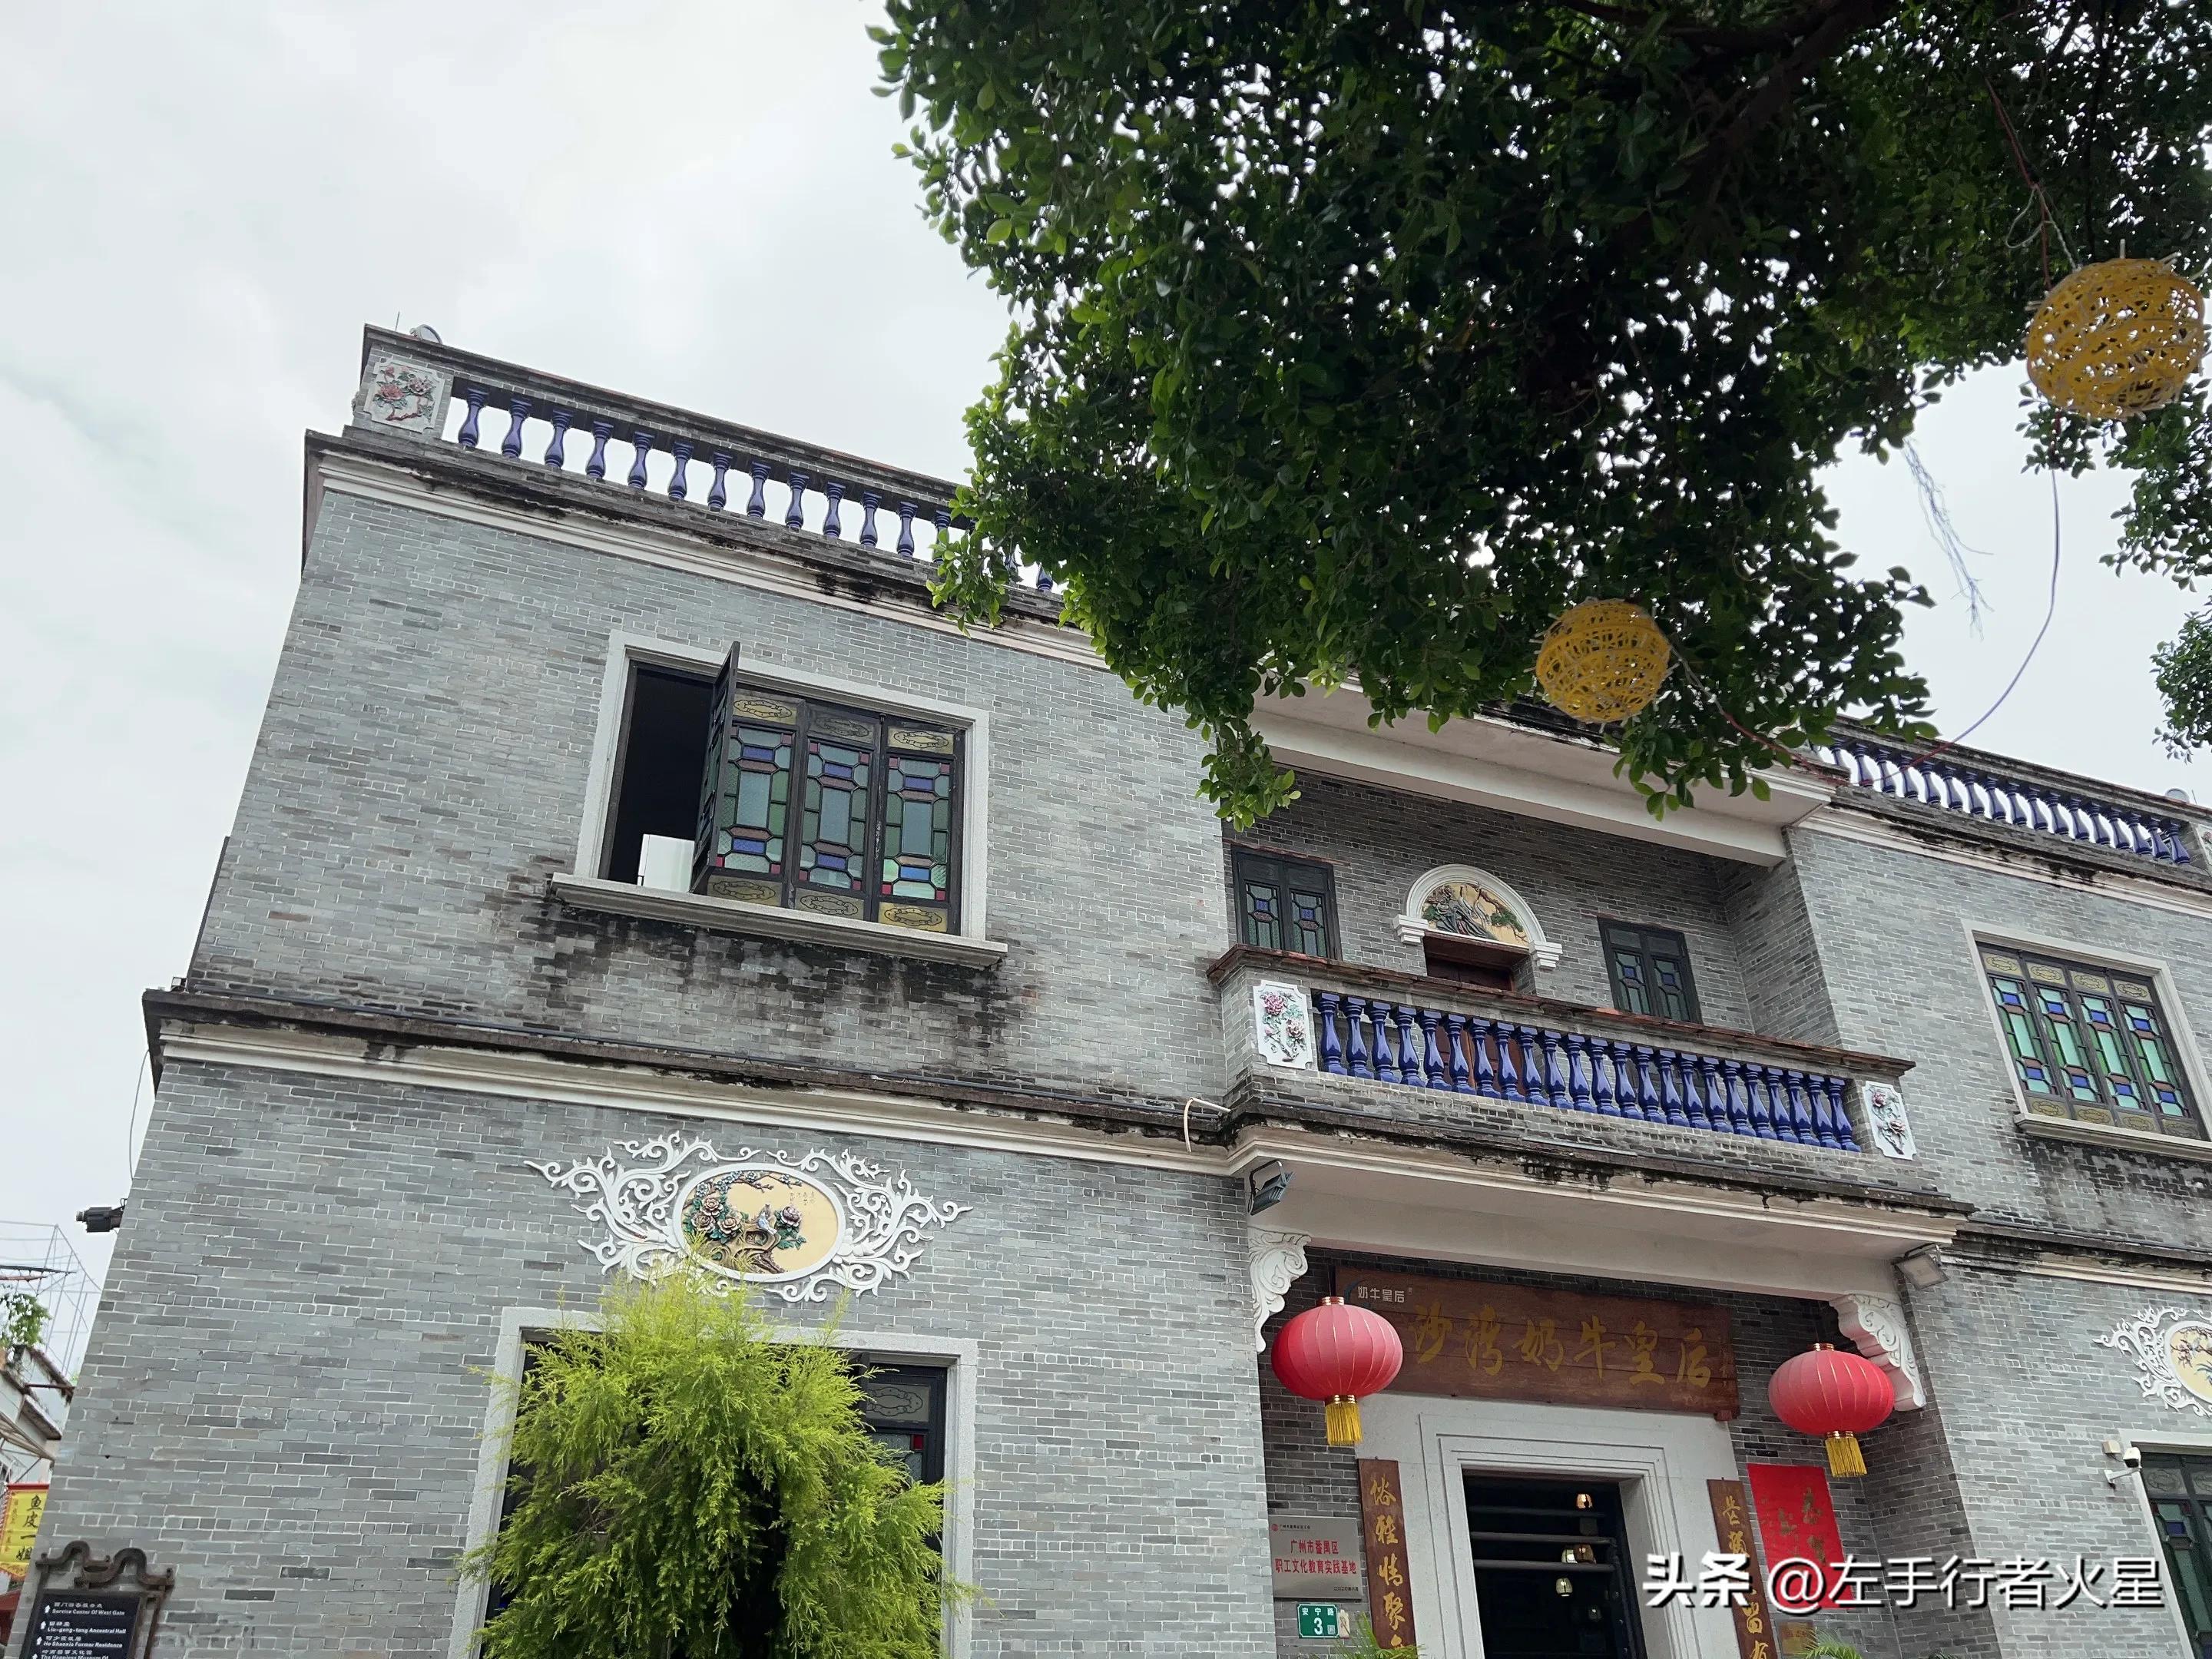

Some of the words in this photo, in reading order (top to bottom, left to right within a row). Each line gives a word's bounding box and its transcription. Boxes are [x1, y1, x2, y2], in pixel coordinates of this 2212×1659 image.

[1357, 1286, 1405, 1303] 奶牛皇后
[1290, 1539, 1339, 1555] 广州市番禺区
[1274, 1558, 1356, 1575] 职工文化教育实践基地
[1302, 1608, 1334, 1616] 安宁路
[1313, 1617, 1323, 1635] 3
